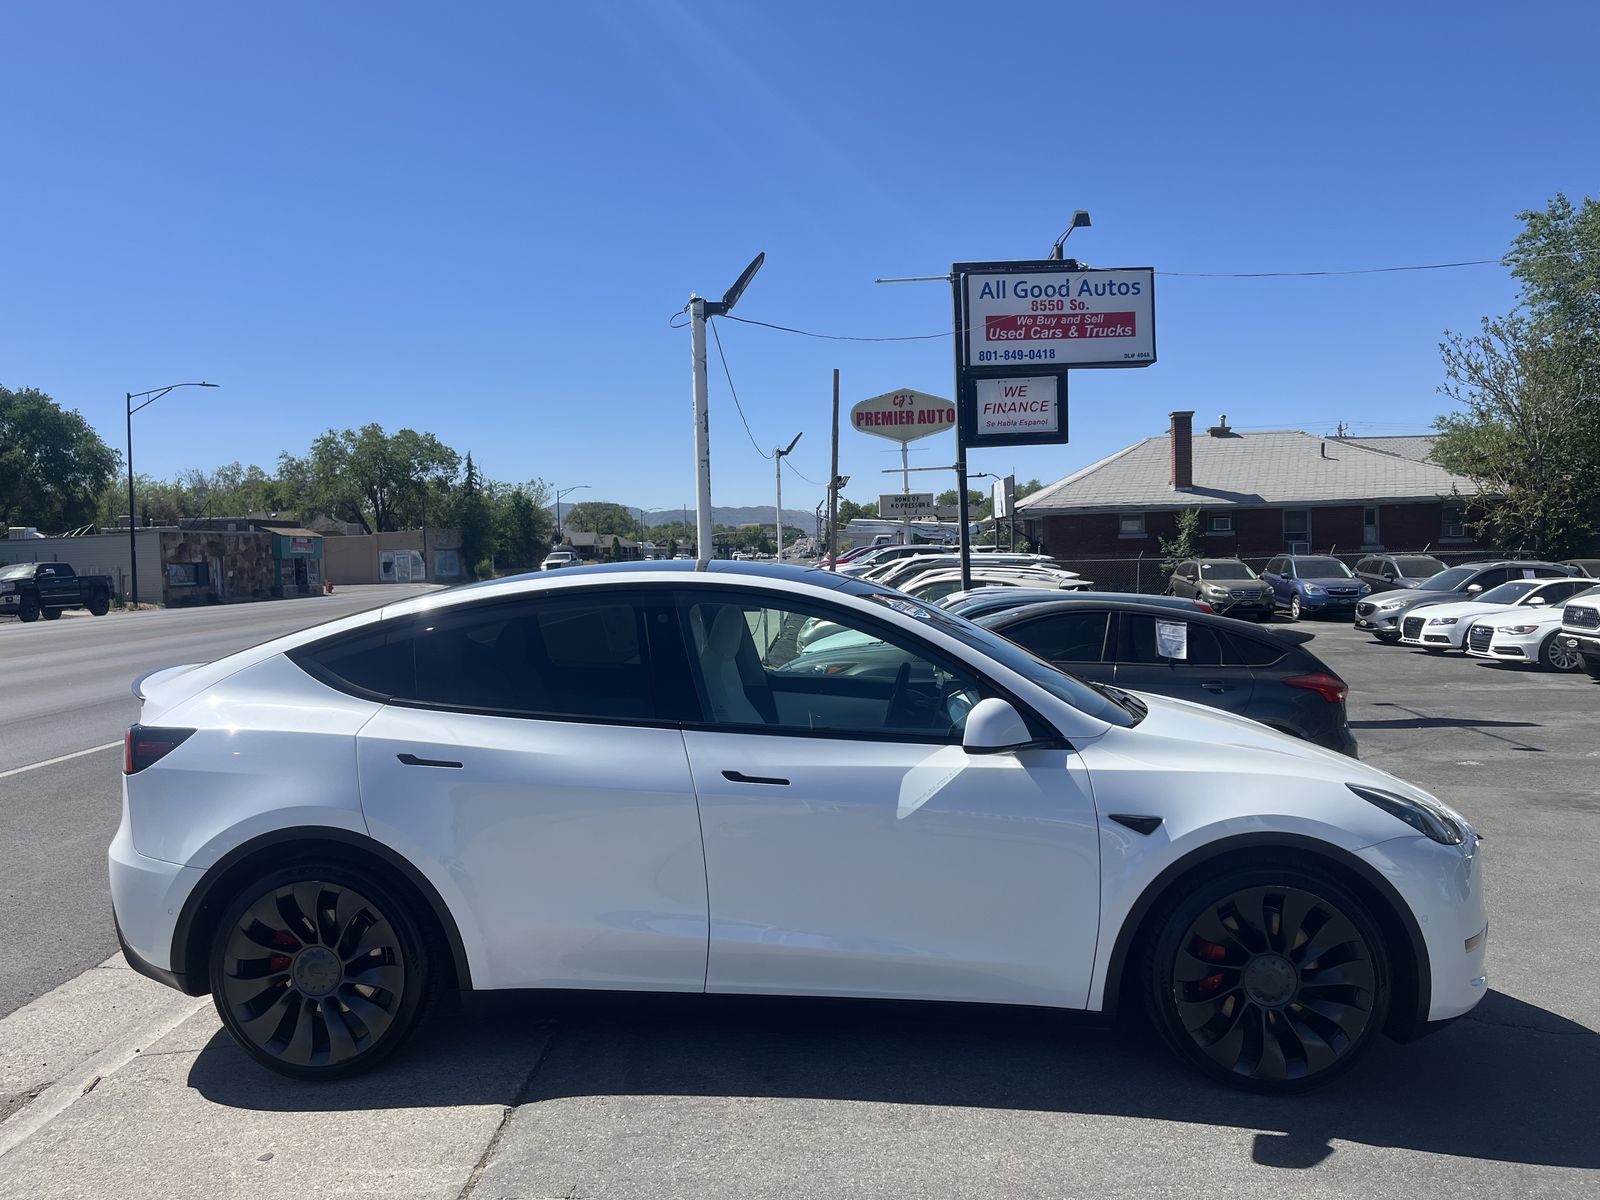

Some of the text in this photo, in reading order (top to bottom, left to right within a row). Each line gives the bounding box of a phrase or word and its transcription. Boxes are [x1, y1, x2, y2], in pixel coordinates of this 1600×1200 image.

[979, 279, 1141, 299] All Good Autos
[1031, 299, 1090, 312] 8550 So.
[1016, 313, 1104, 327] We Buy and Sell
[989, 324, 1133, 340] Used Cars & Trucks
[978, 348, 1056, 362] 801-849-0418
[1004, 385, 1028, 398] WE
[983, 400, 1049, 415] FINANCE
[856, 407, 955, 427] PREMIER AUTO
[996, 419, 1018, 427] Habla
